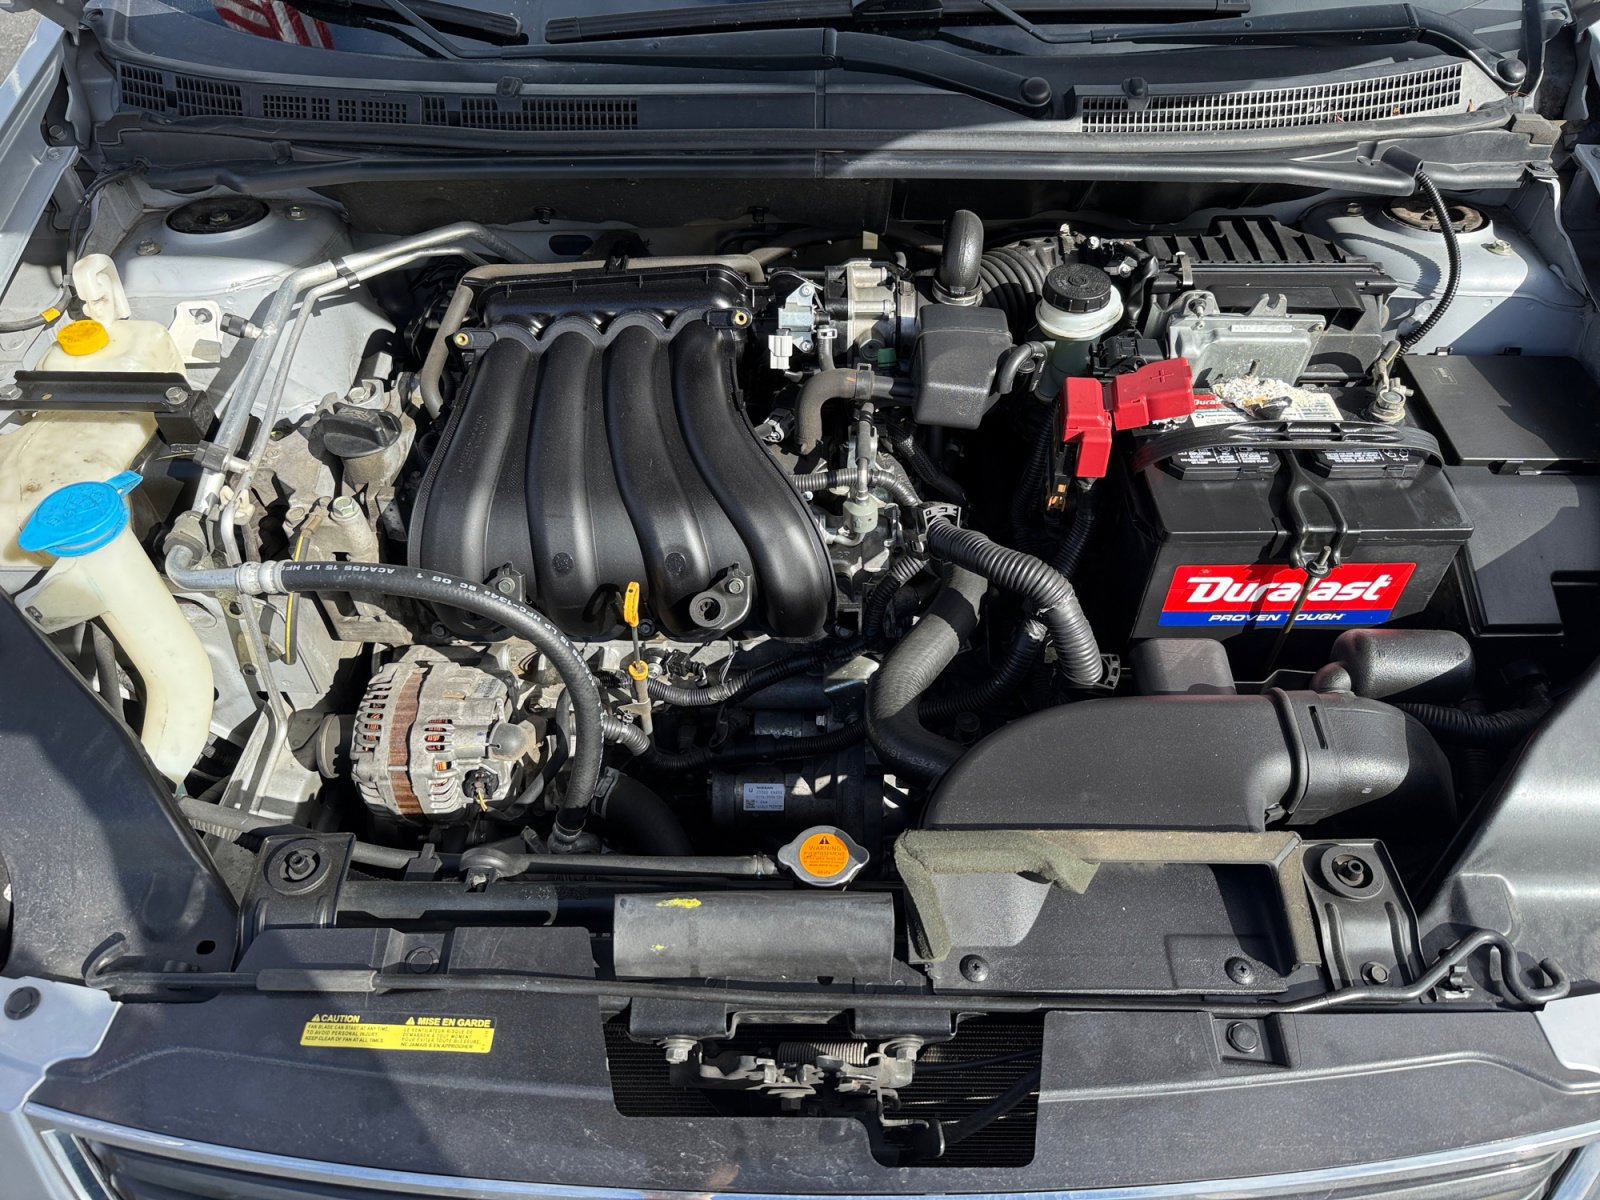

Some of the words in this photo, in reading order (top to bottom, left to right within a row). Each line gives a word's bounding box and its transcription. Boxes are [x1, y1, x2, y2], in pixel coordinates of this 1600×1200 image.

[1207, 613, 1281, 622] PROVEN
[1287, 613, 1344, 621] OUGH
[321, 1014, 360, 1023] CAUTION
[417, 1017, 441, 1026] MISE
[457, 1019, 491, 1027] GARDE
